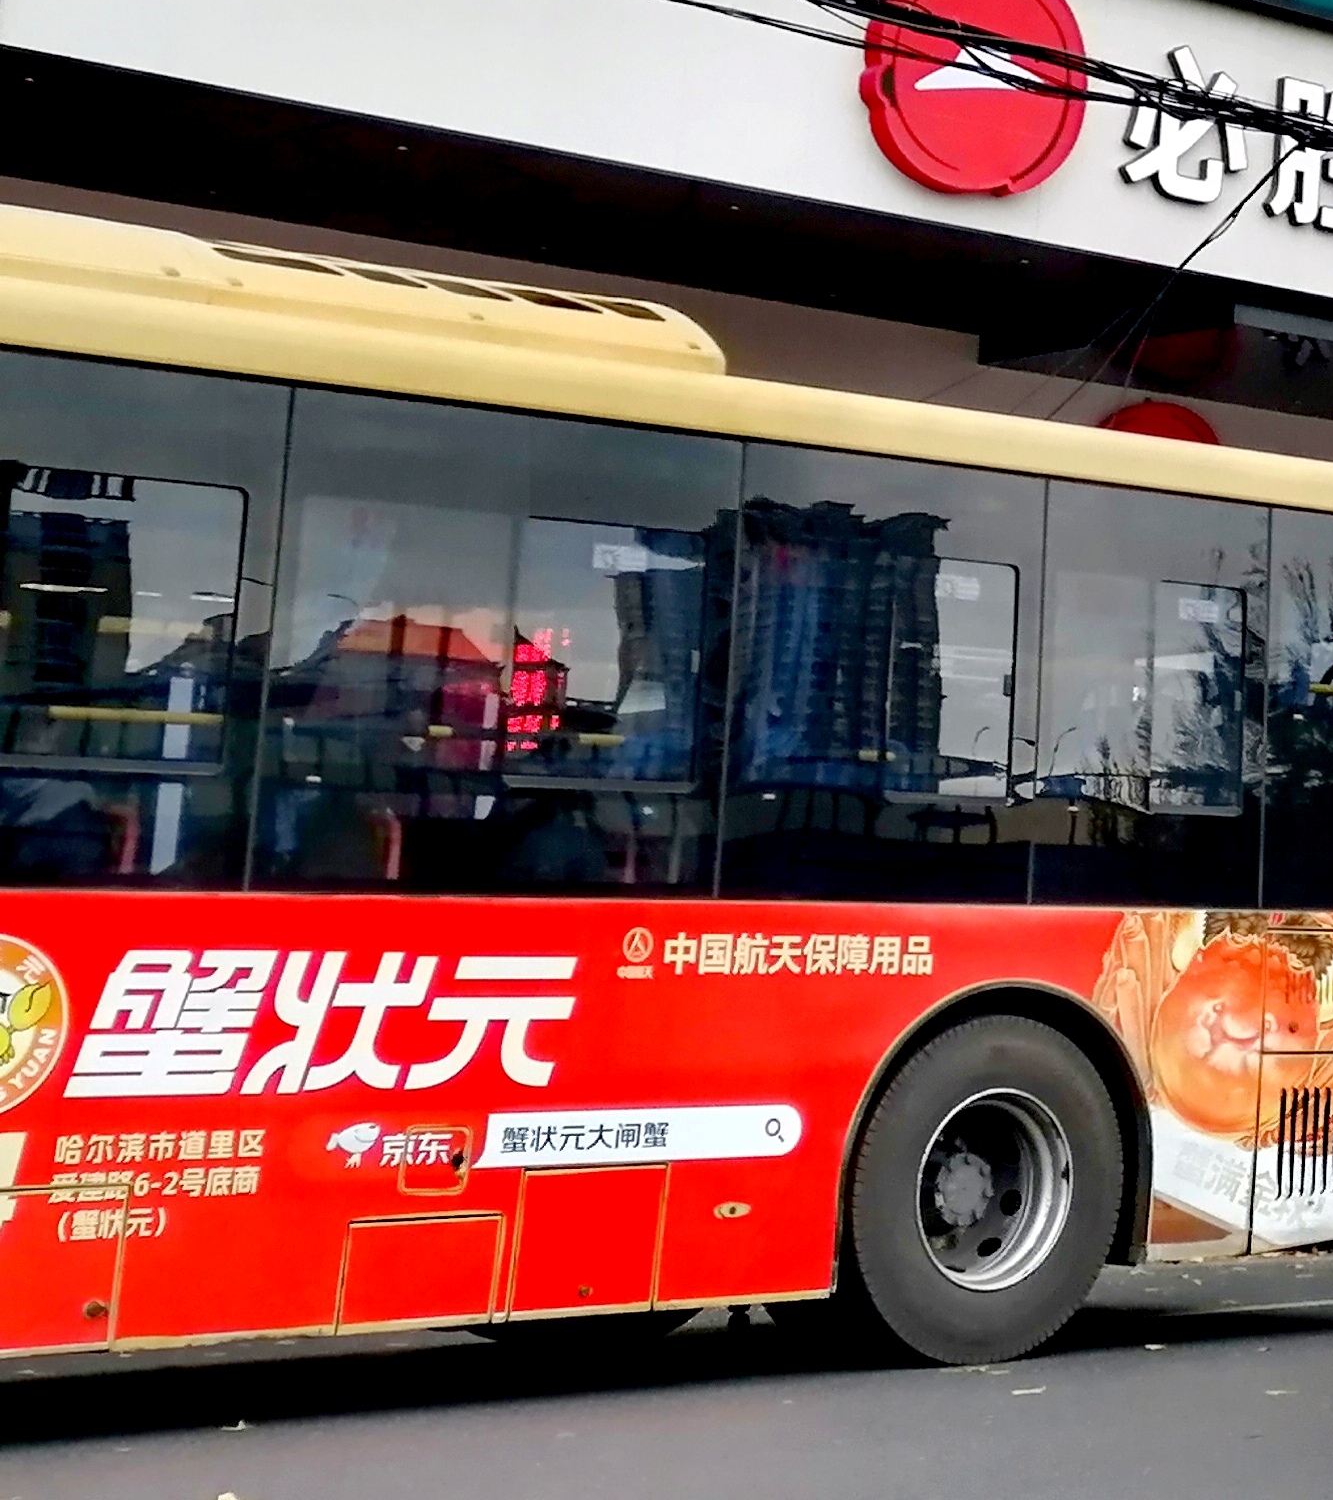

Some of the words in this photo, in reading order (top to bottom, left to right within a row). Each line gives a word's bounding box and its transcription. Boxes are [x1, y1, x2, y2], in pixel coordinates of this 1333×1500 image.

[663, 932, 934, 975] 中国航天保障用品
[63, 949, 577, 1098] 蟹状元
[54, 1129, 266, 1166] 哈尔滨市道里区
[379, 1132, 453, 1167] 京东
[500, 1122, 669, 1155] 蟹状元大闸蟹
